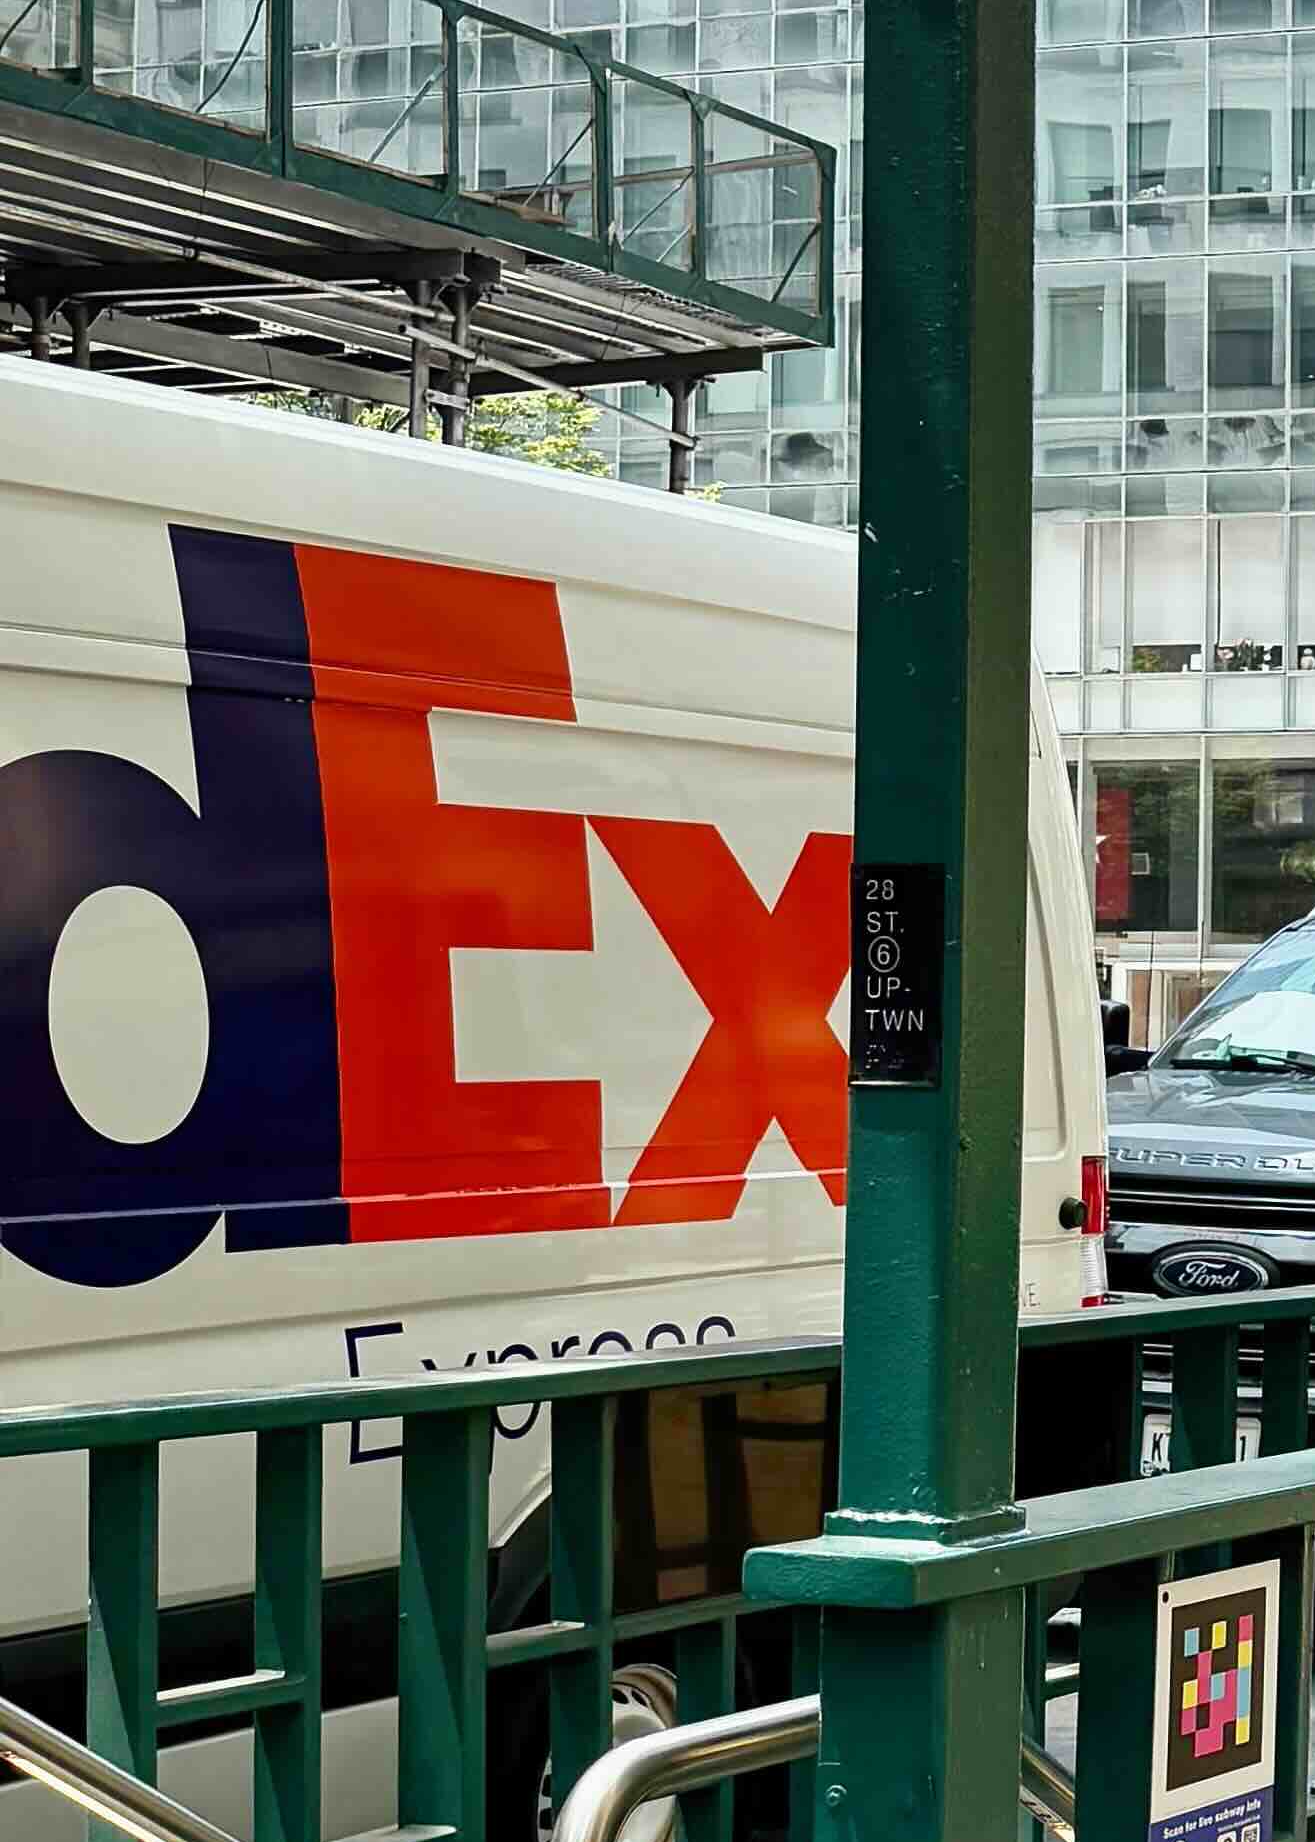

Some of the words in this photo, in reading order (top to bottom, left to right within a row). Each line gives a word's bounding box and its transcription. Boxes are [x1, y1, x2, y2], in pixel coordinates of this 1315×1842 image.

[865, 879, 895, 900] 28
[877, 943, 890, 965] 6
[865, 1009, 924, 1032] TWN
[1178, 1260, 1240, 1290] Ford
